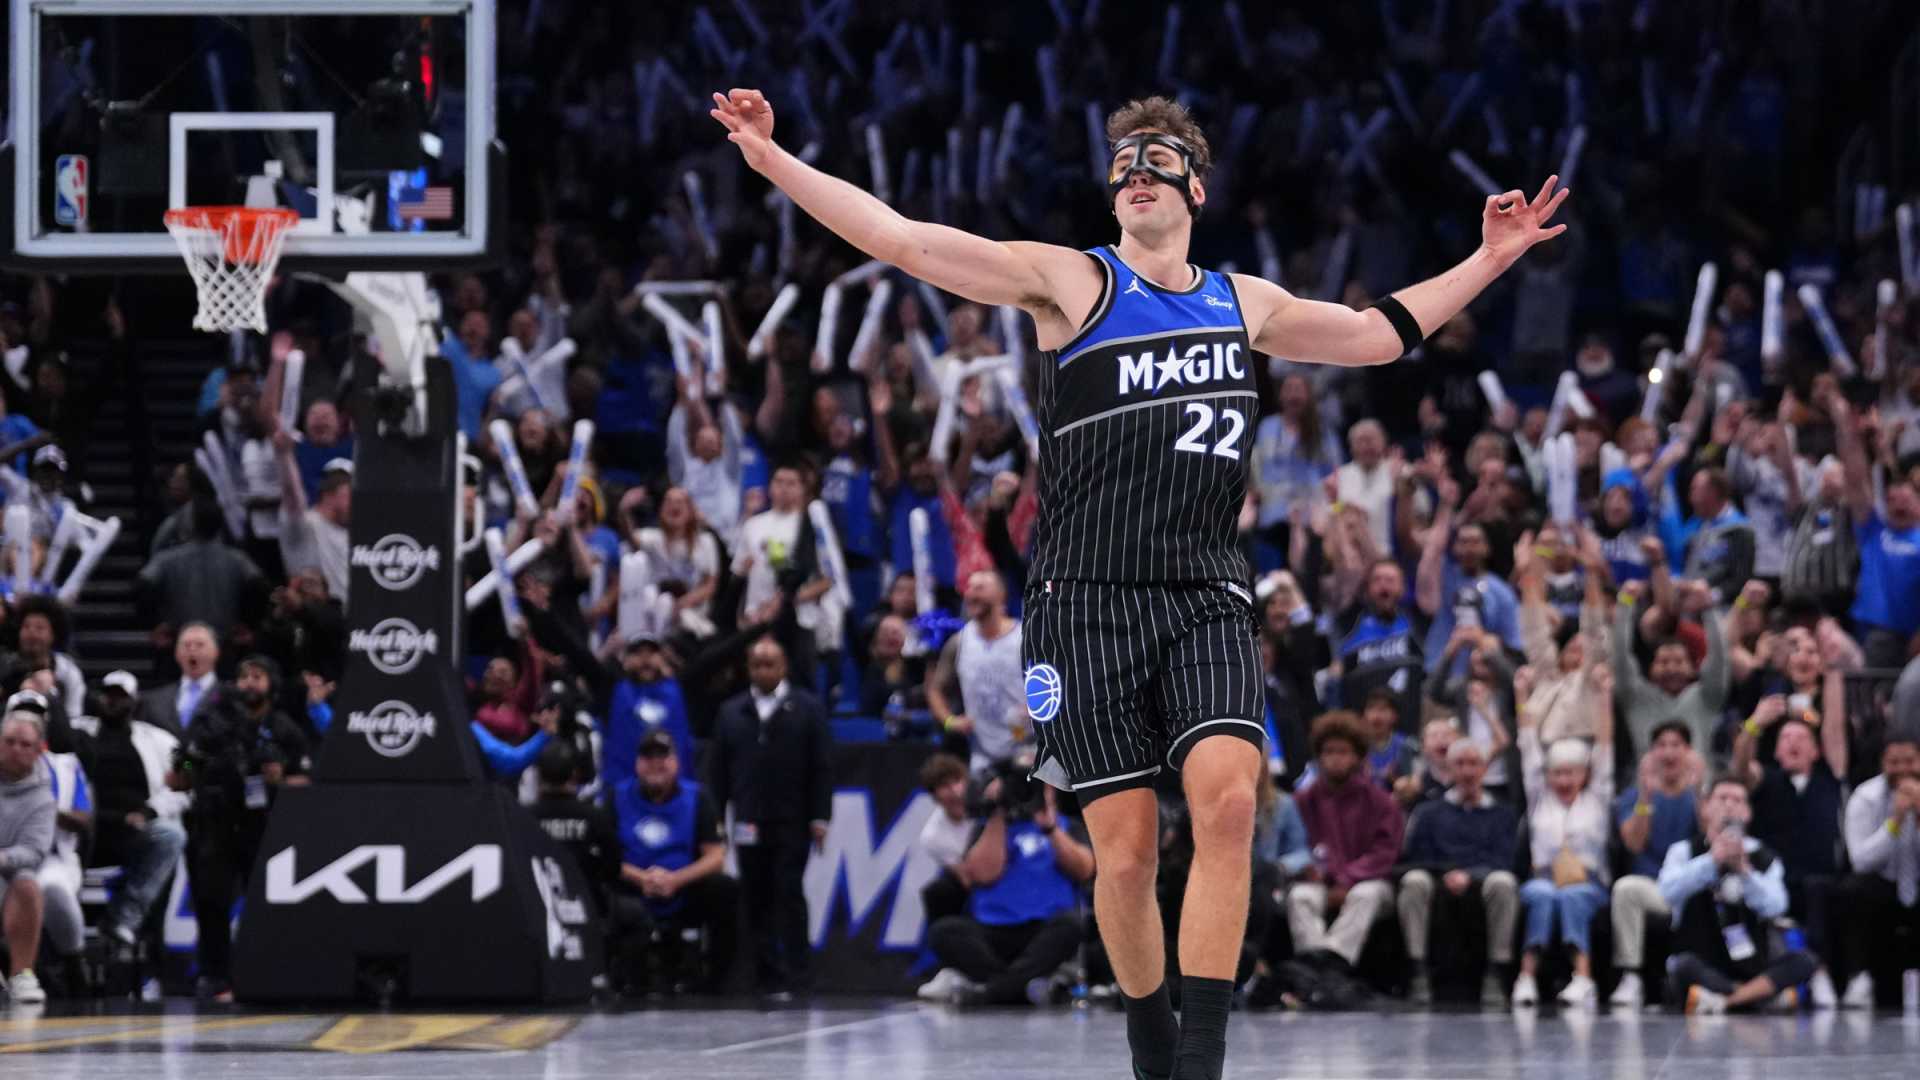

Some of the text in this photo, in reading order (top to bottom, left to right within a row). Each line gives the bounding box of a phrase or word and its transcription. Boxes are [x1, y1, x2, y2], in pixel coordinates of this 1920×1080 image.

[1201, 294, 1233, 311] Disney
[1174, 402, 1246, 460] 22
[351, 544, 397, 567] Hard
[349, 628, 395, 651] Hard
[347, 711, 394, 733] Hard
